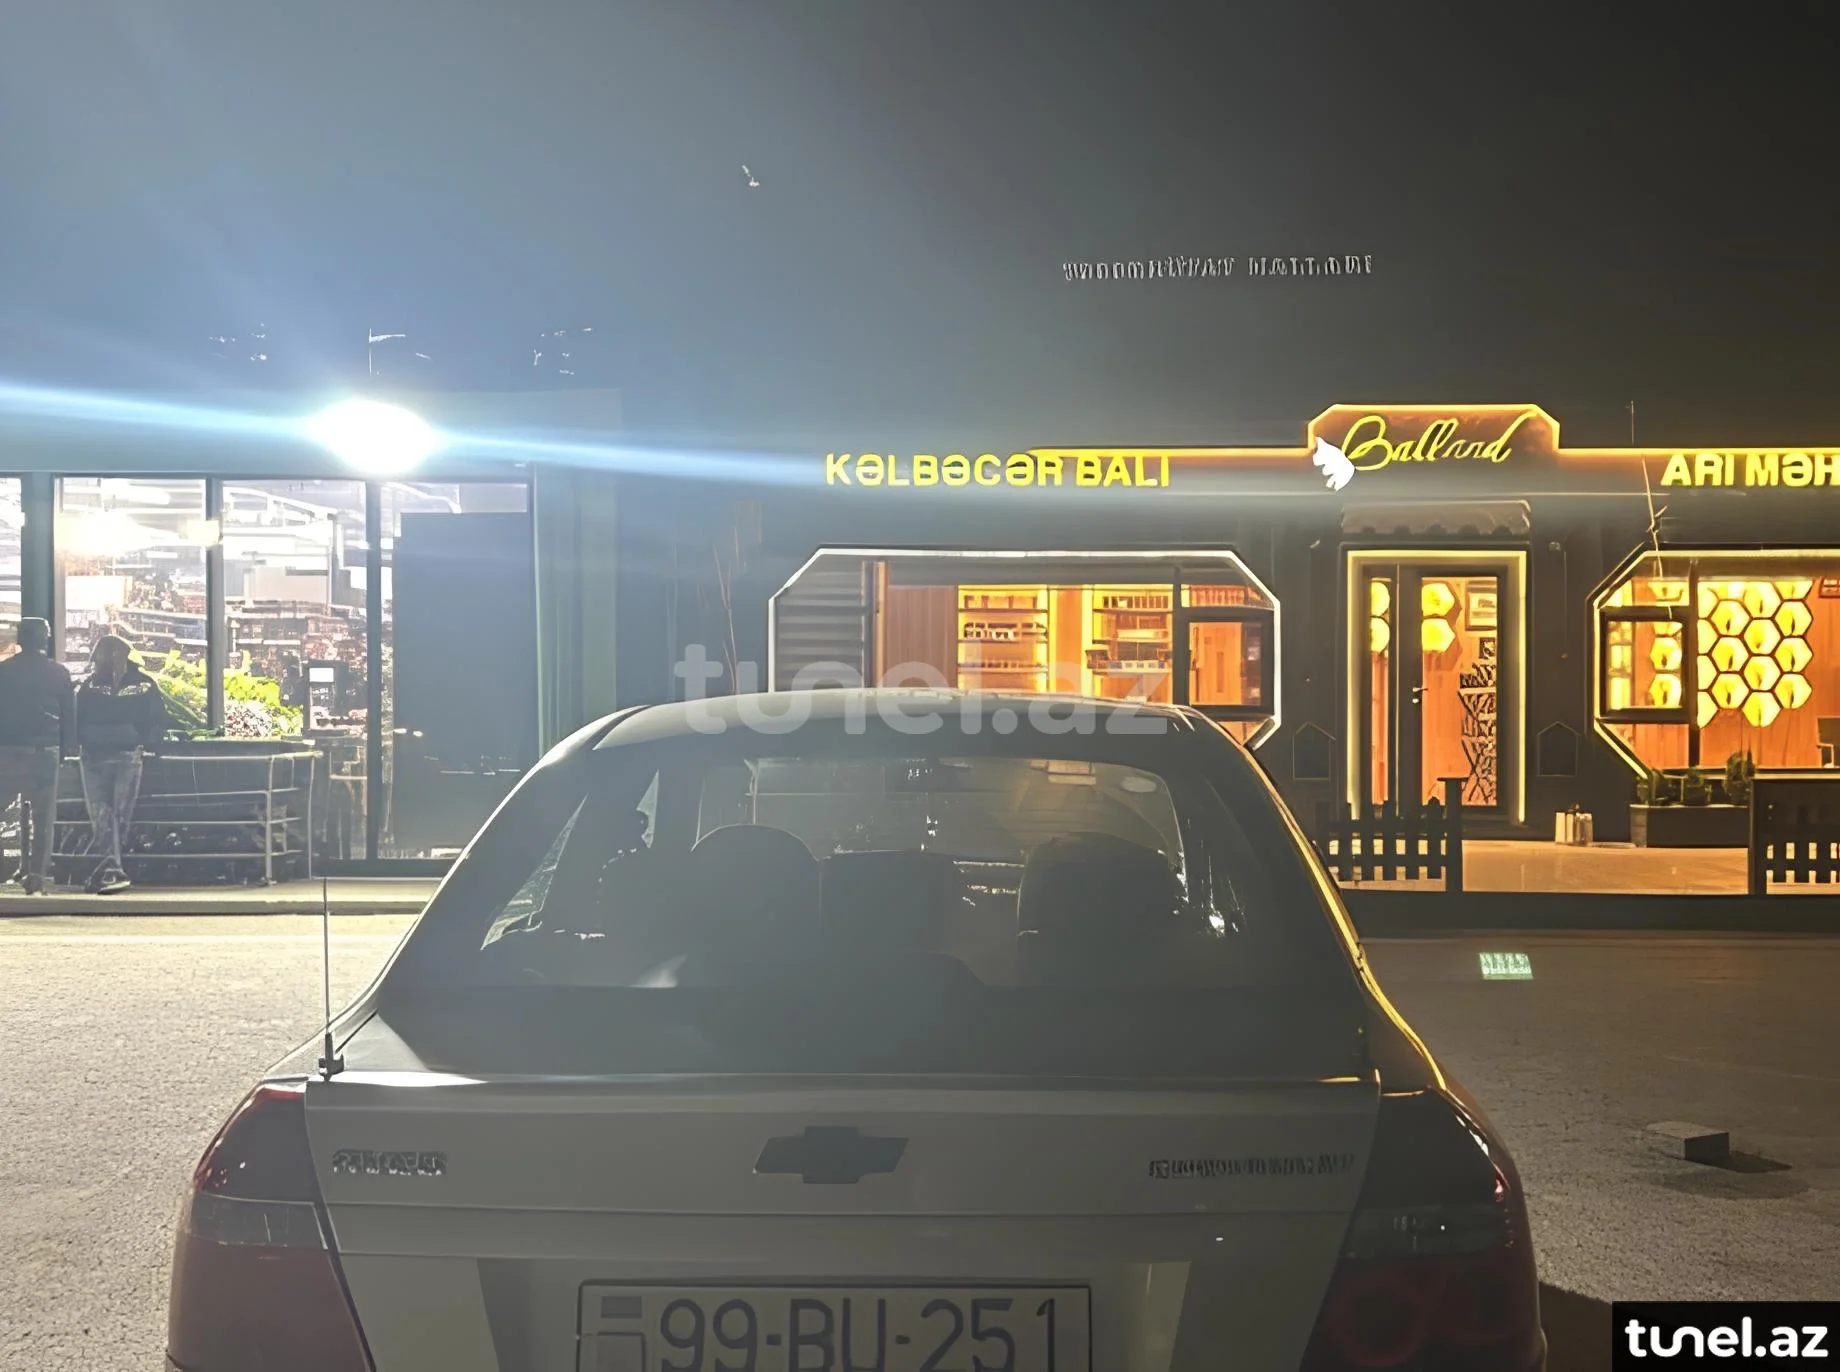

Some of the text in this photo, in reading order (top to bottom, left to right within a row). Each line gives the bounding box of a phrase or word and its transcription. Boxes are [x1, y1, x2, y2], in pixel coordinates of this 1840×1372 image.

[826, 453, 1170, 487] KƏLBƏCƏR BALI
[1660, 453, 1840, 488] ARI MƏH
